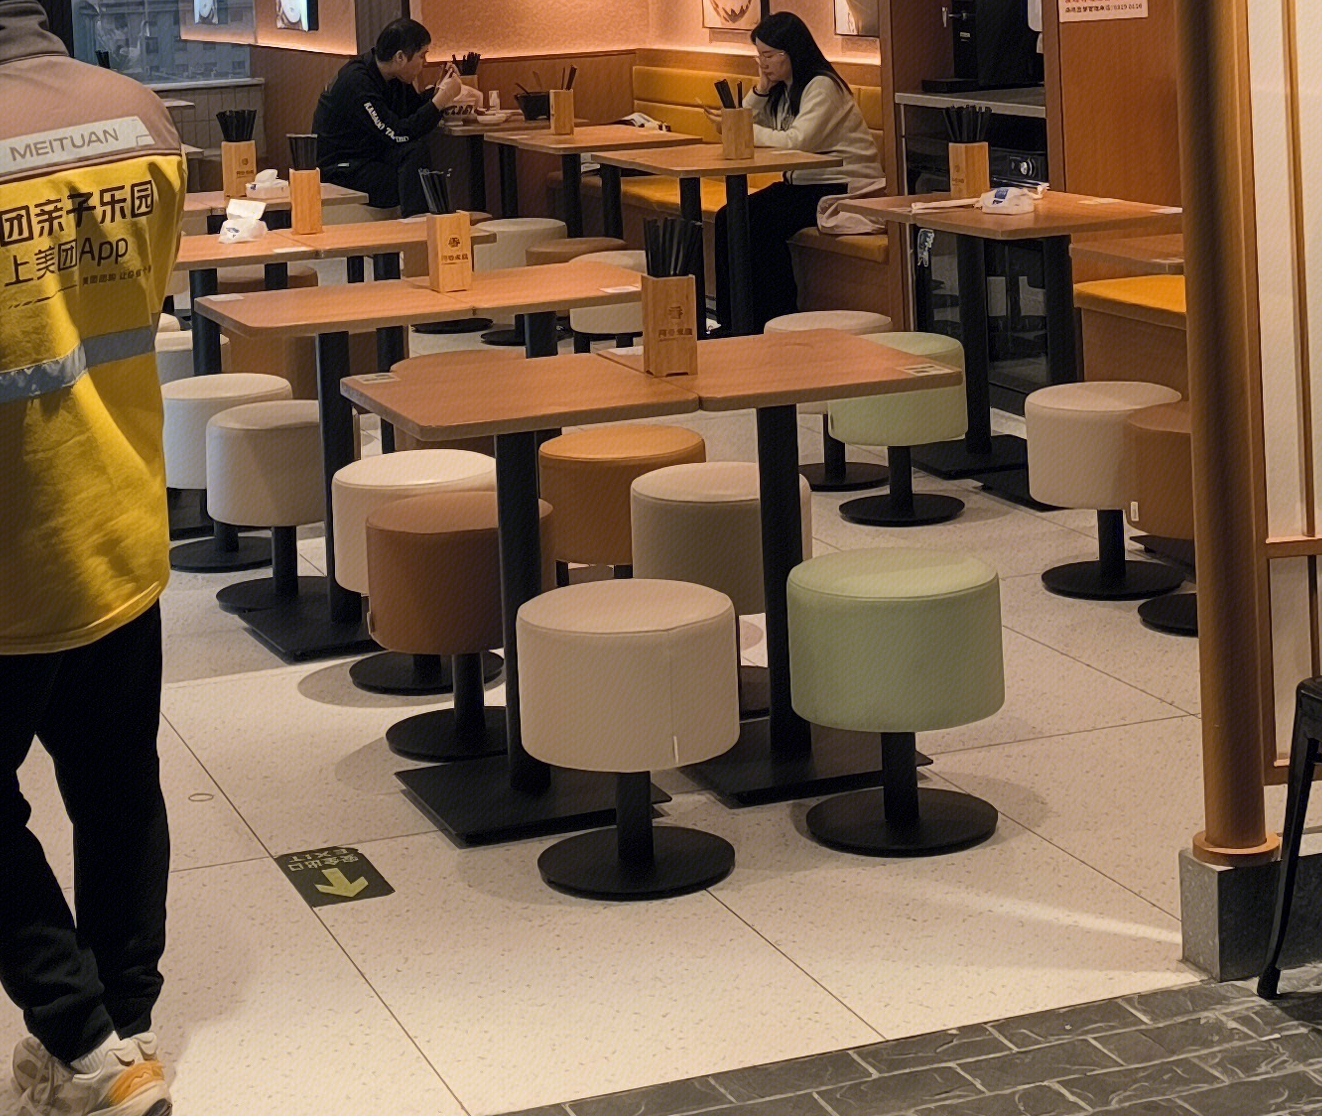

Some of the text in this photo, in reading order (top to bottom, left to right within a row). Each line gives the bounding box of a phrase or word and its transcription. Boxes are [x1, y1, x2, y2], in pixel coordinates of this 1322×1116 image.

[10, 127, 120, 162] MEITUAN
[4, 236, 129, 287] 上美团App
[290, 847, 349, 863] EXIT
